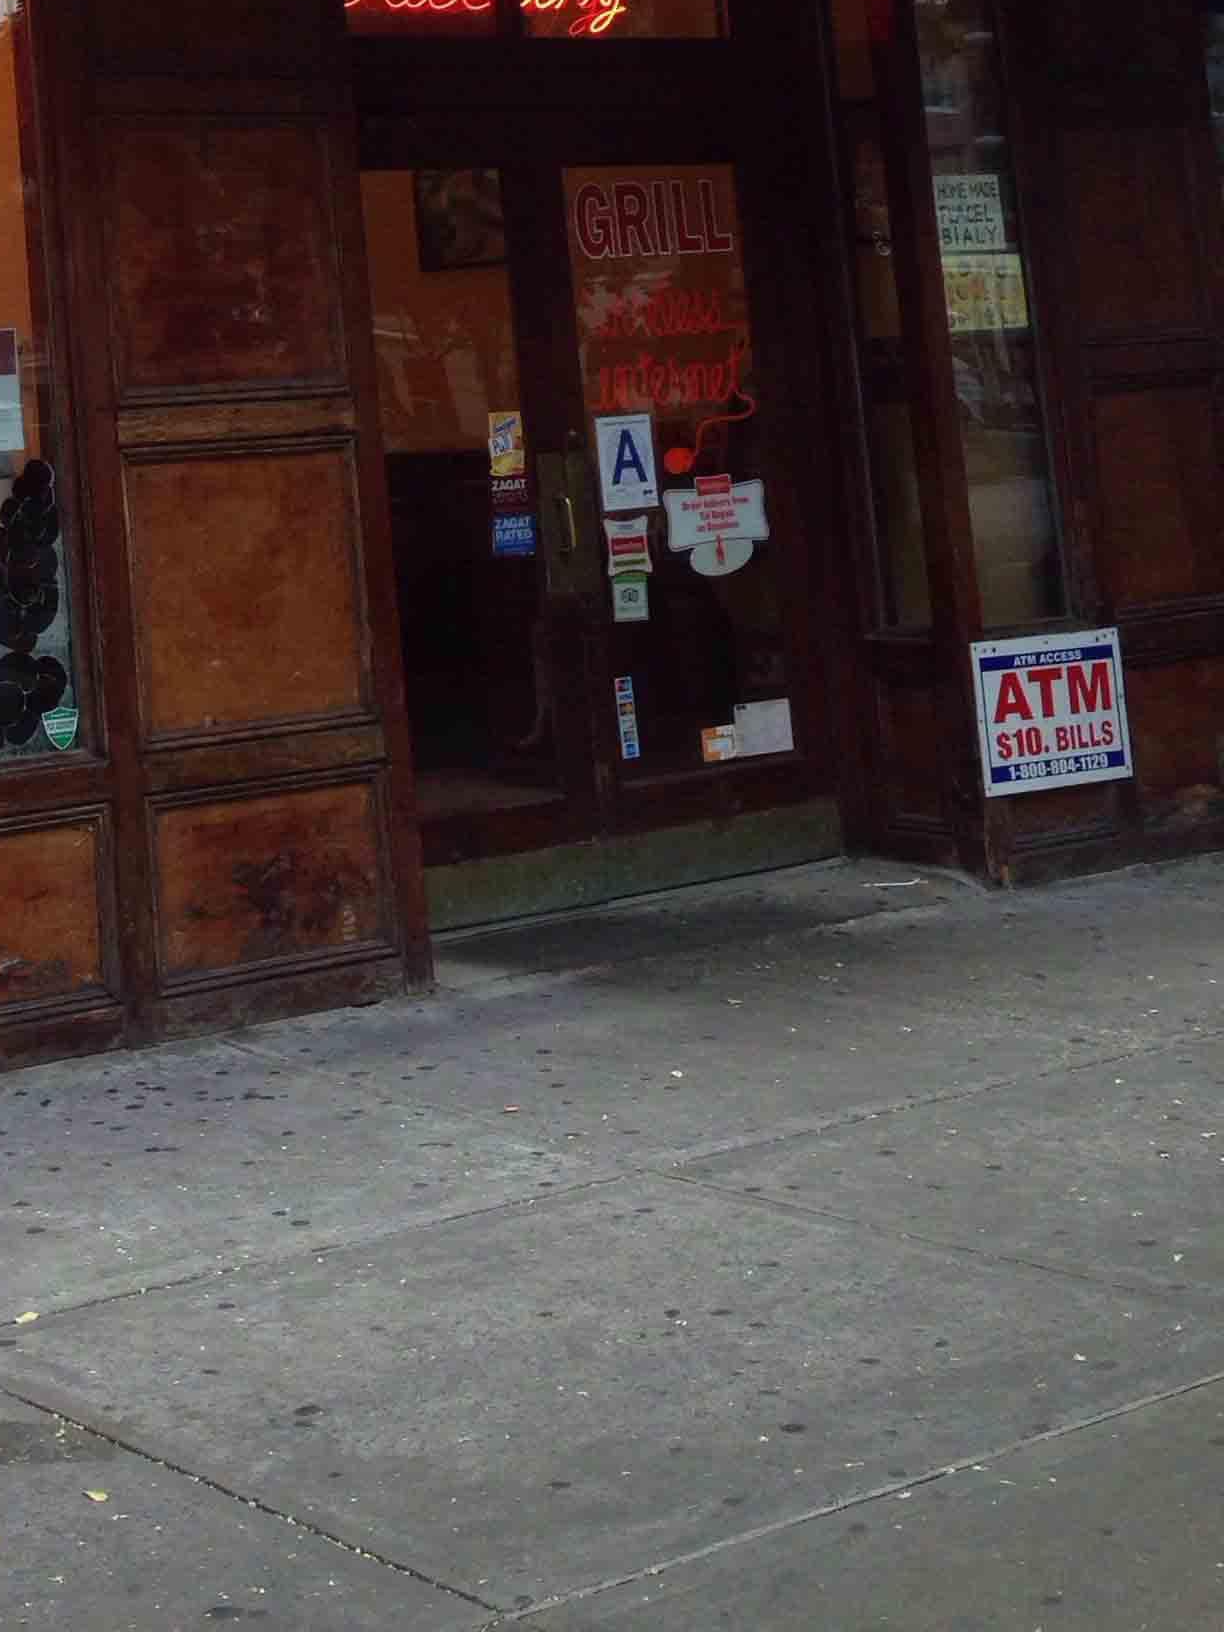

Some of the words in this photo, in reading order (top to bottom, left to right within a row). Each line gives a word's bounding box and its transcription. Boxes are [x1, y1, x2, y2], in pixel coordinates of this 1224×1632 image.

[575, 178, 736, 260] GRILL
[611, 428, 649, 486] A
[1013, 654, 1037, 667] ATM
[1039, 649, 1083, 664] ACCESS
[993, 661, 1113, 725] ATM
[996, 727, 1051, 762] $10.
[1055, 720, 1114, 752] BILLS
